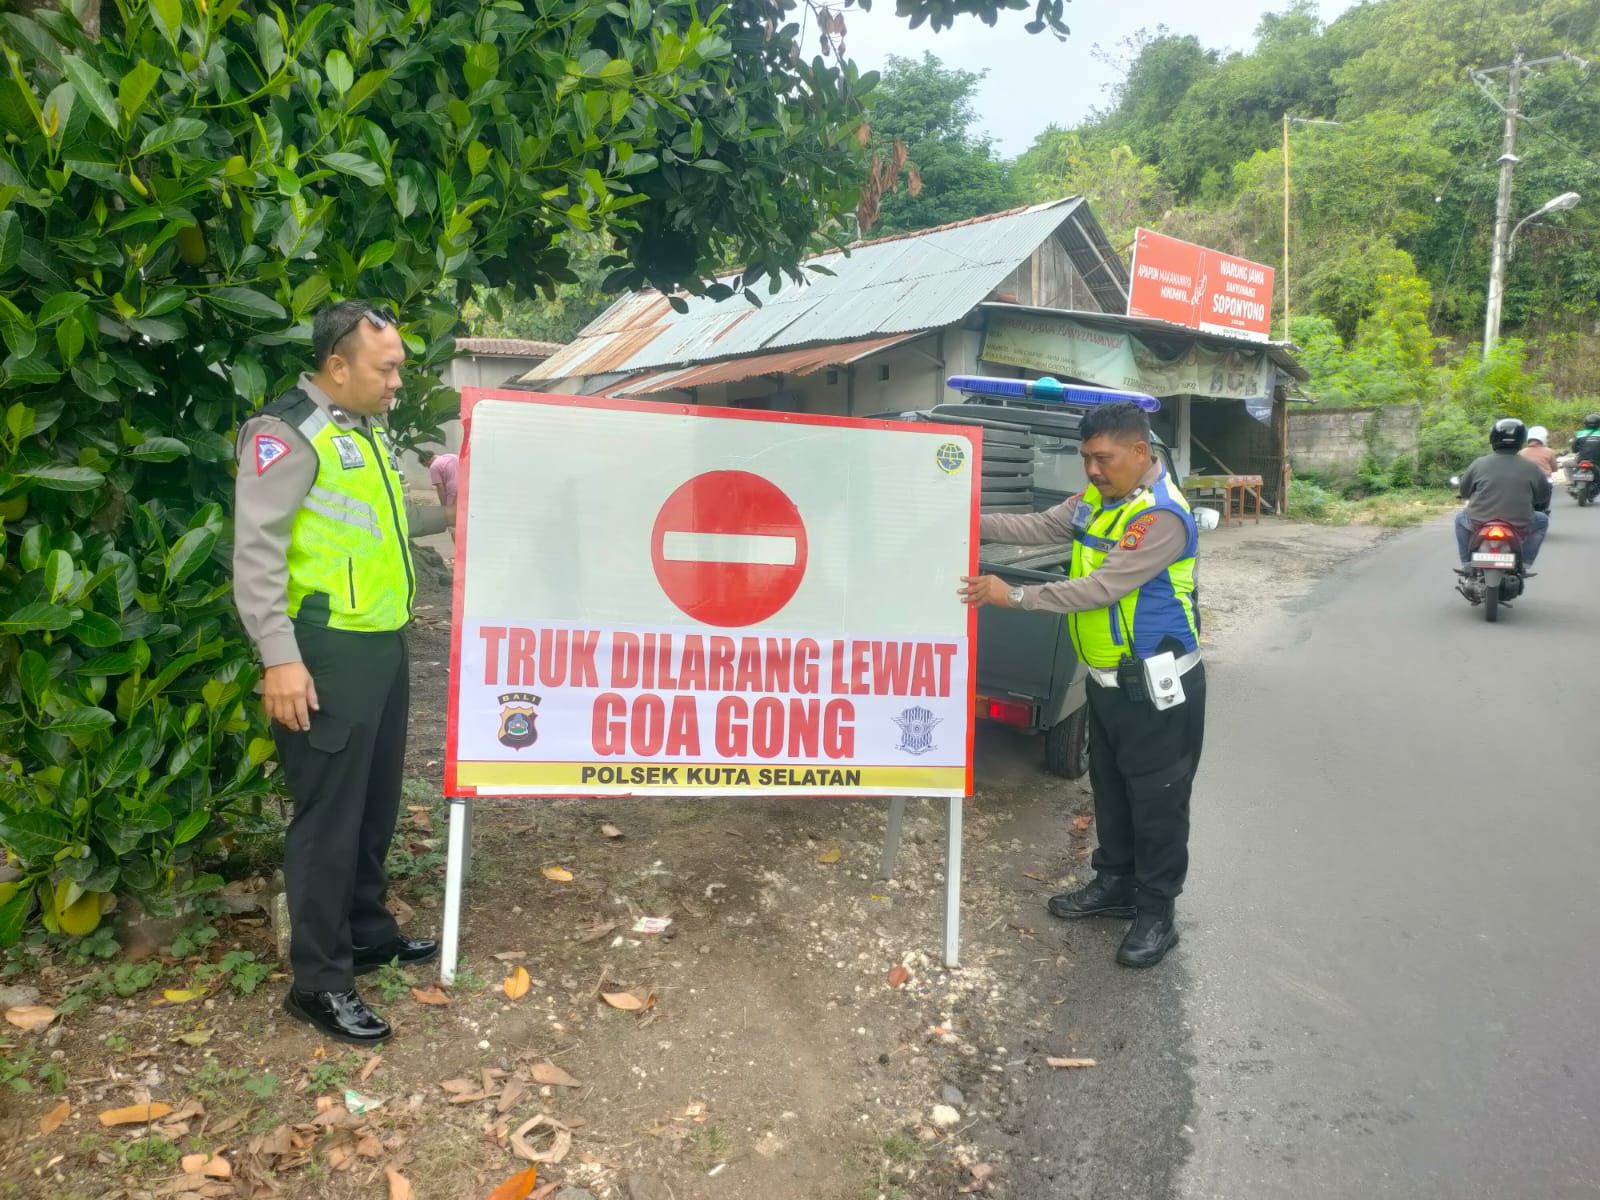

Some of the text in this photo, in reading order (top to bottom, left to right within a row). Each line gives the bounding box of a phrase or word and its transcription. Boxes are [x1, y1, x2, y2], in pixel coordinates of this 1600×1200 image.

[1137, 264, 1159, 281] APAPUN
[1220, 260, 1265, 286] WARUNG JAWA
[1212, 293, 1265, 322] SOPONYONO
[480, 626, 958, 697] TRUK DILARANG LEWAT
[502, 694, 536, 702] BALI
[591, 692, 856, 759] GOA GONG
[581, 766, 861, 786] POLSEK KUTA SELATAN
